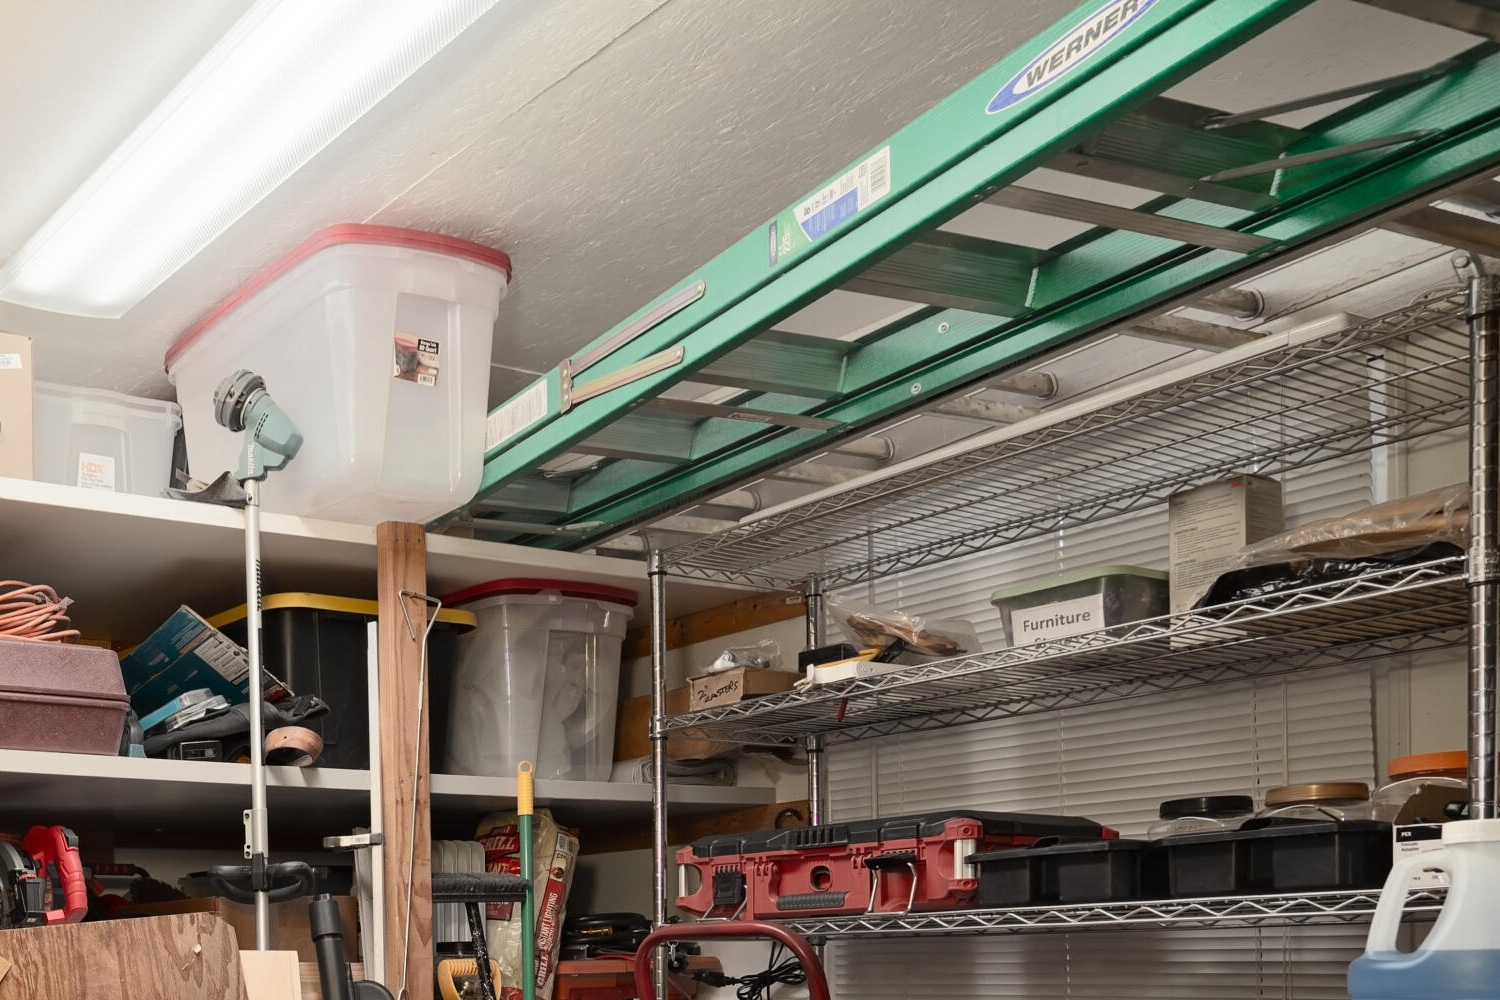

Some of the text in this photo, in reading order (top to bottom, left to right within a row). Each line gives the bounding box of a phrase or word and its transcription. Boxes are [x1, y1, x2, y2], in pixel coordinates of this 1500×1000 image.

[1026, 0, 1140, 88] WERNER
[1022, 611, 1092, 633] Furniture
[544, 892, 558, 922] LIGHTING
[536, 952, 549, 985] GRILL
